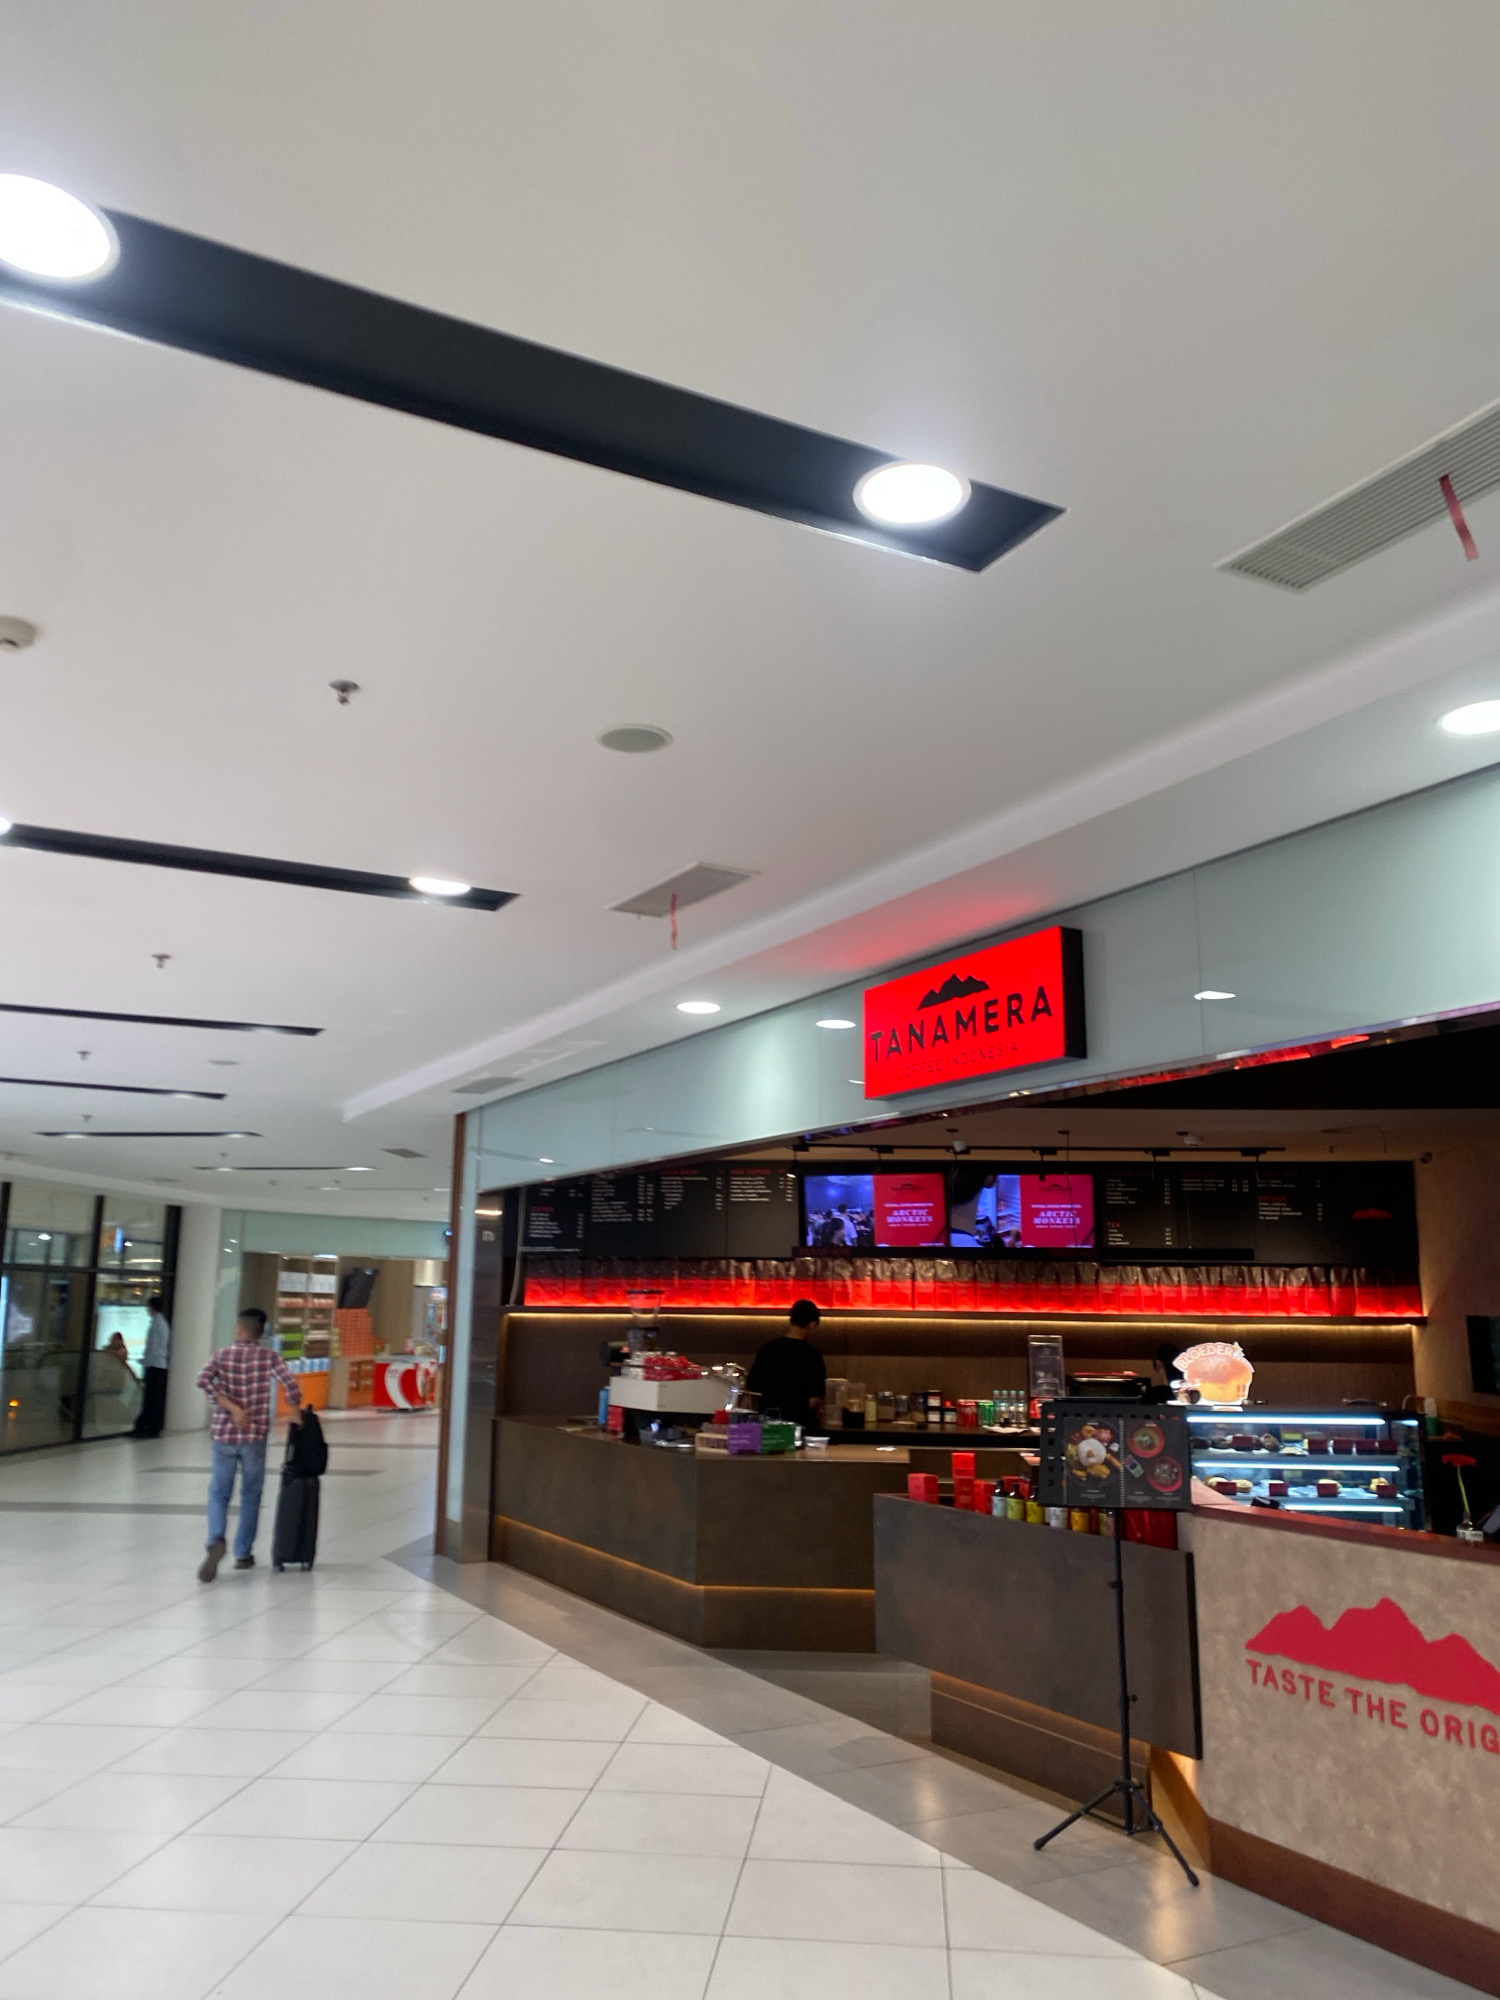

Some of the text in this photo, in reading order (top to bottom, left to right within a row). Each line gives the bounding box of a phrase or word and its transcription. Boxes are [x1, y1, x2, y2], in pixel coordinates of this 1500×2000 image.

[871, 985, 1053, 1062] TANAMERA
[897, 1041, 1019, 1081] COFFEE INDONESIA
[886, 1215, 934, 1223] MONKEYS
[1176, 1344, 1234, 1370] BLOEDER
[1246, 1658, 1500, 1755] TASTE THE ORIG
